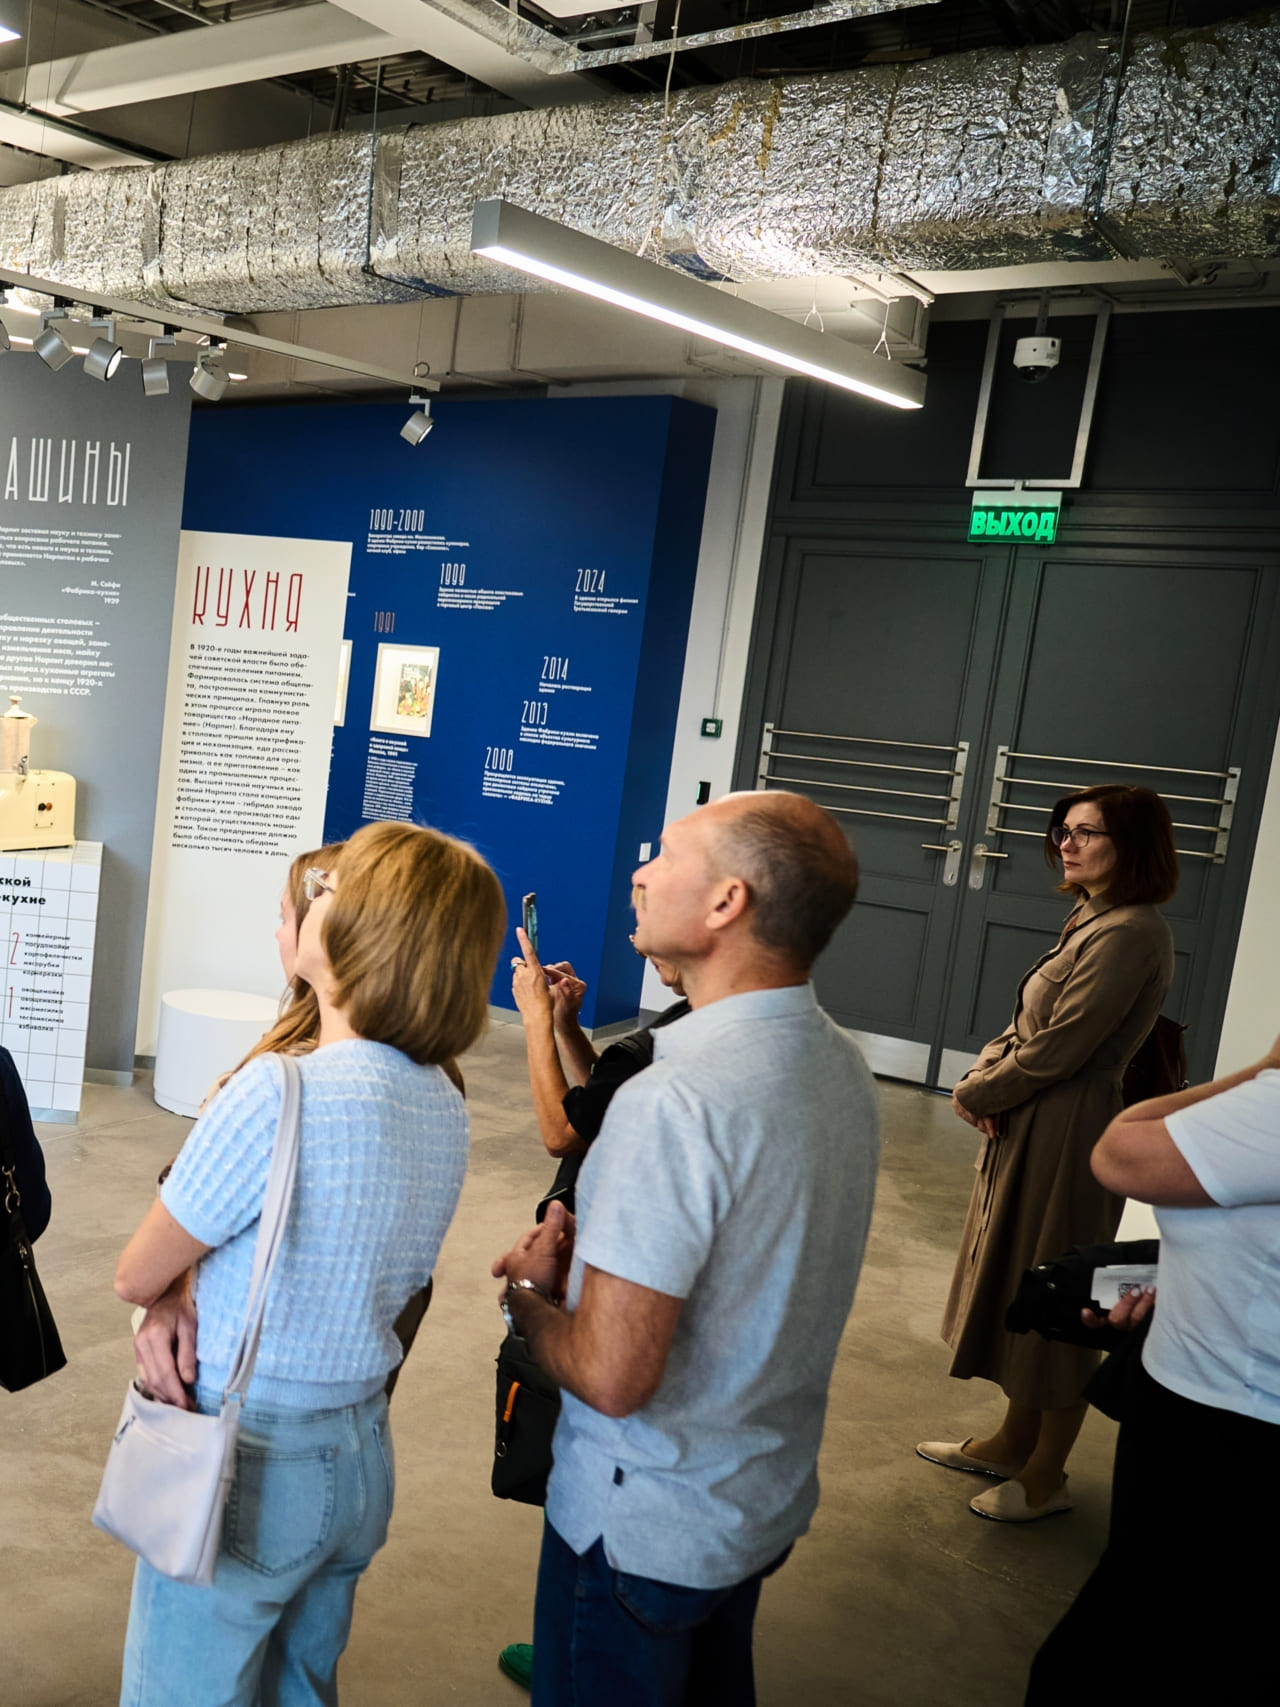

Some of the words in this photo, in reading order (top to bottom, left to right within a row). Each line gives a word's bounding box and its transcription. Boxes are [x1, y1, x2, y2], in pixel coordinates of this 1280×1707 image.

[970, 511, 1056, 541] ВЫХОД
[575, 568, 606, 593] 2024
[192, 565, 303, 633] КУХНЯ
[540, 656, 569, 680] 2014
[520, 700, 548, 725] 2013
[10, 931, 20, 965] 2
